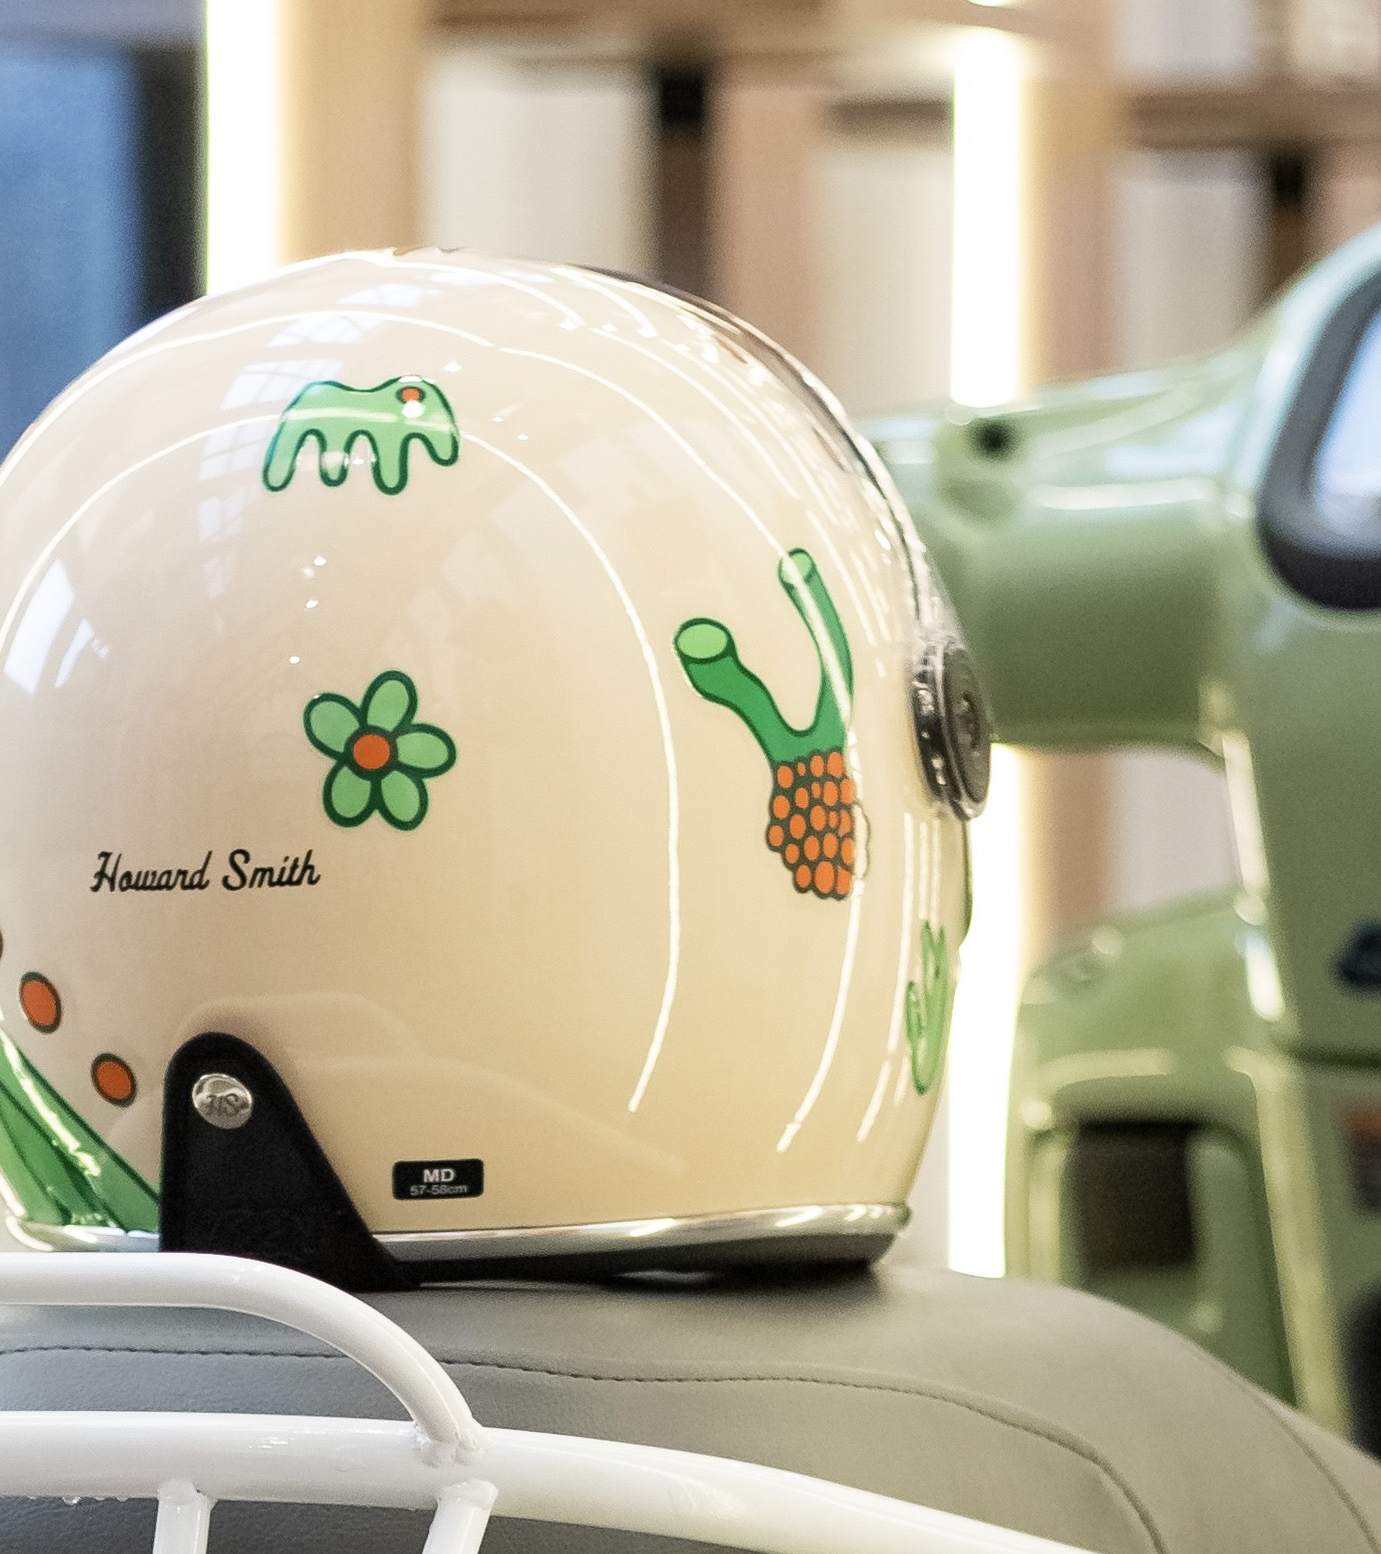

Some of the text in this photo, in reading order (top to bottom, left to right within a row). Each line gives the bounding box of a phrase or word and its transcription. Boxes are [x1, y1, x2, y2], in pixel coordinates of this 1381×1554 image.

[89, 848, 322, 893] Howard Smith
[423, 1168, 455, 1183] MD
